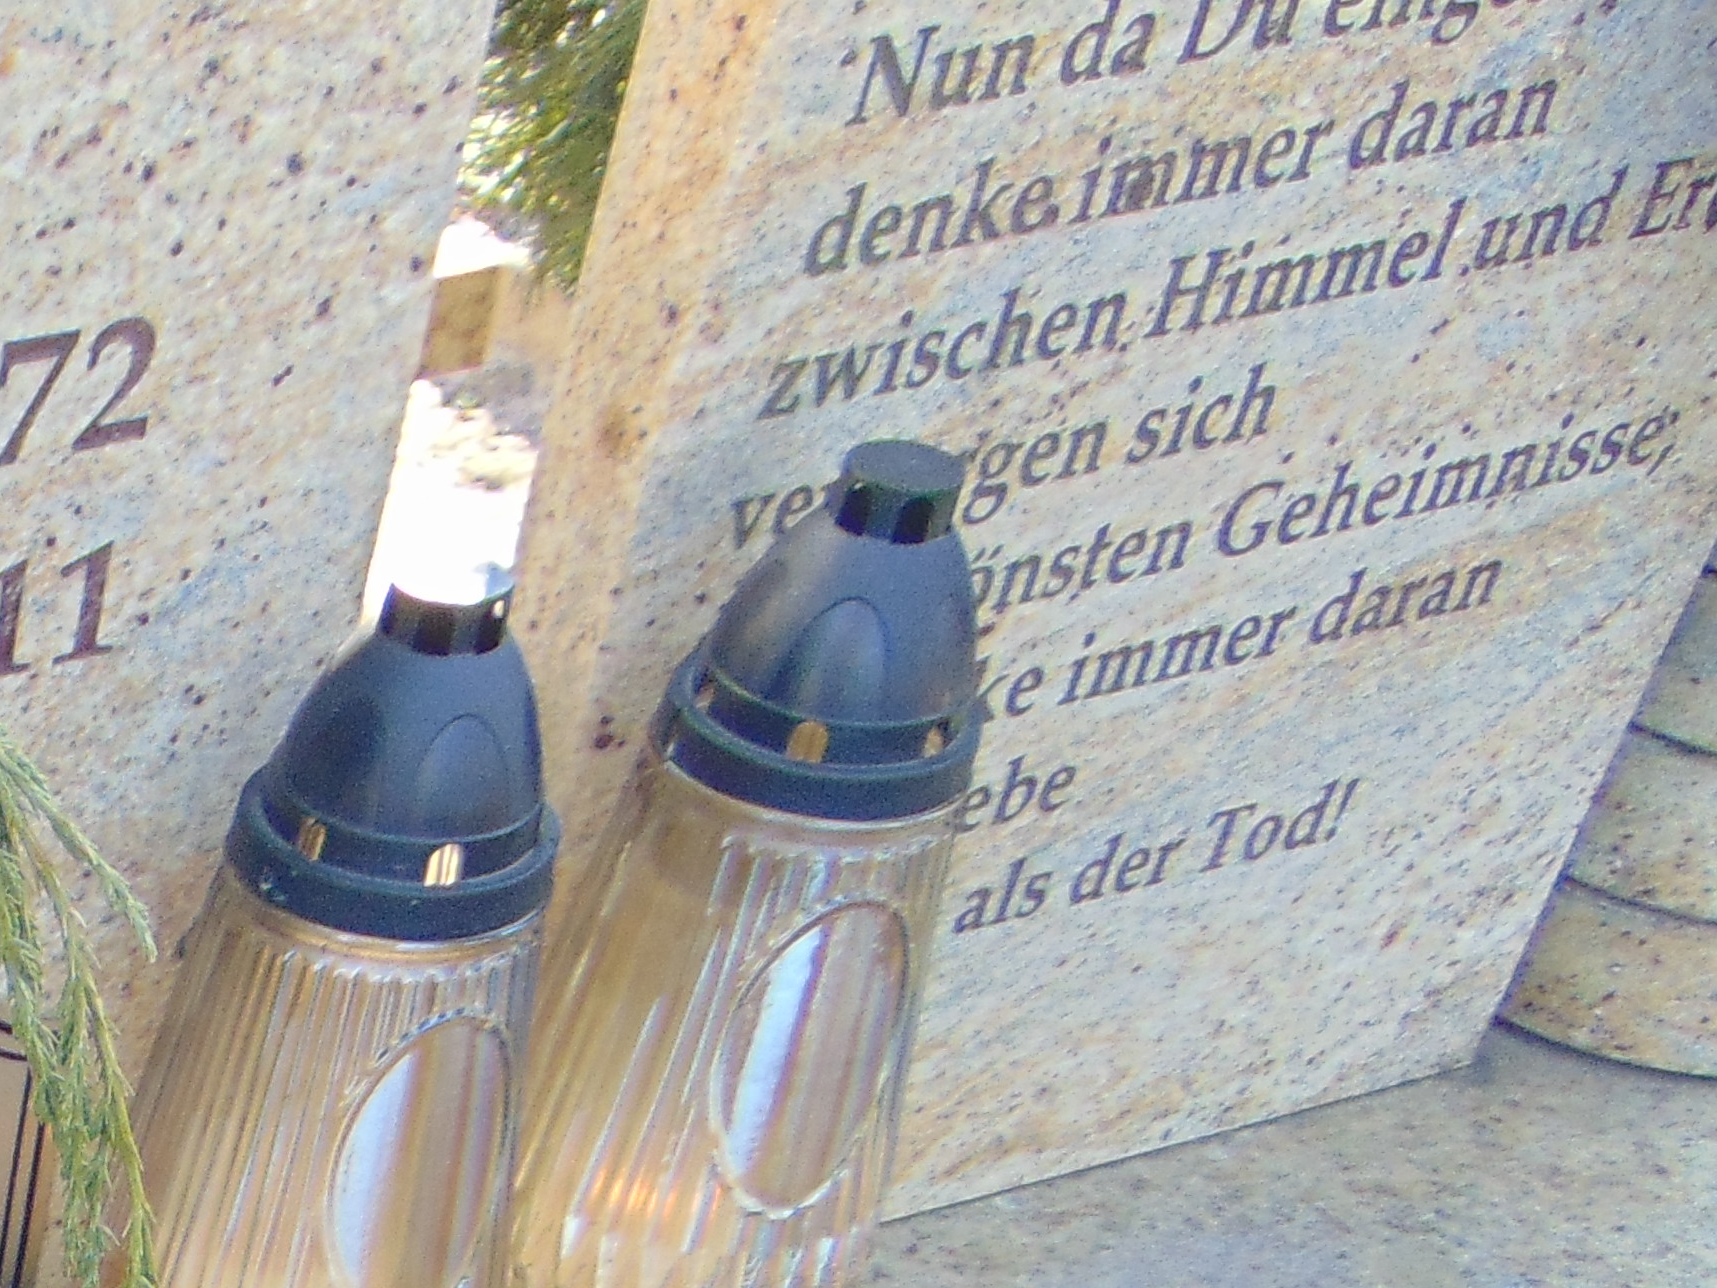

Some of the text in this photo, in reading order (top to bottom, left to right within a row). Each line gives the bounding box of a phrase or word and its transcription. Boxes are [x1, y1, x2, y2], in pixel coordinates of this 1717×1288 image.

[845, 25, 1036, 127] Nun
[1059, 7, 1151, 86] da
[803, 79, 1557, 278] denke immer daran
[755, 157, 1717, 422] zwischen Himmel und Er
[1124, 360, 1279, 467] sich
[1058, 605, 1299, 707] immer
[1308, 567, 1503, 645] daran
[950, 776, 1362, 936] als der Tod!
